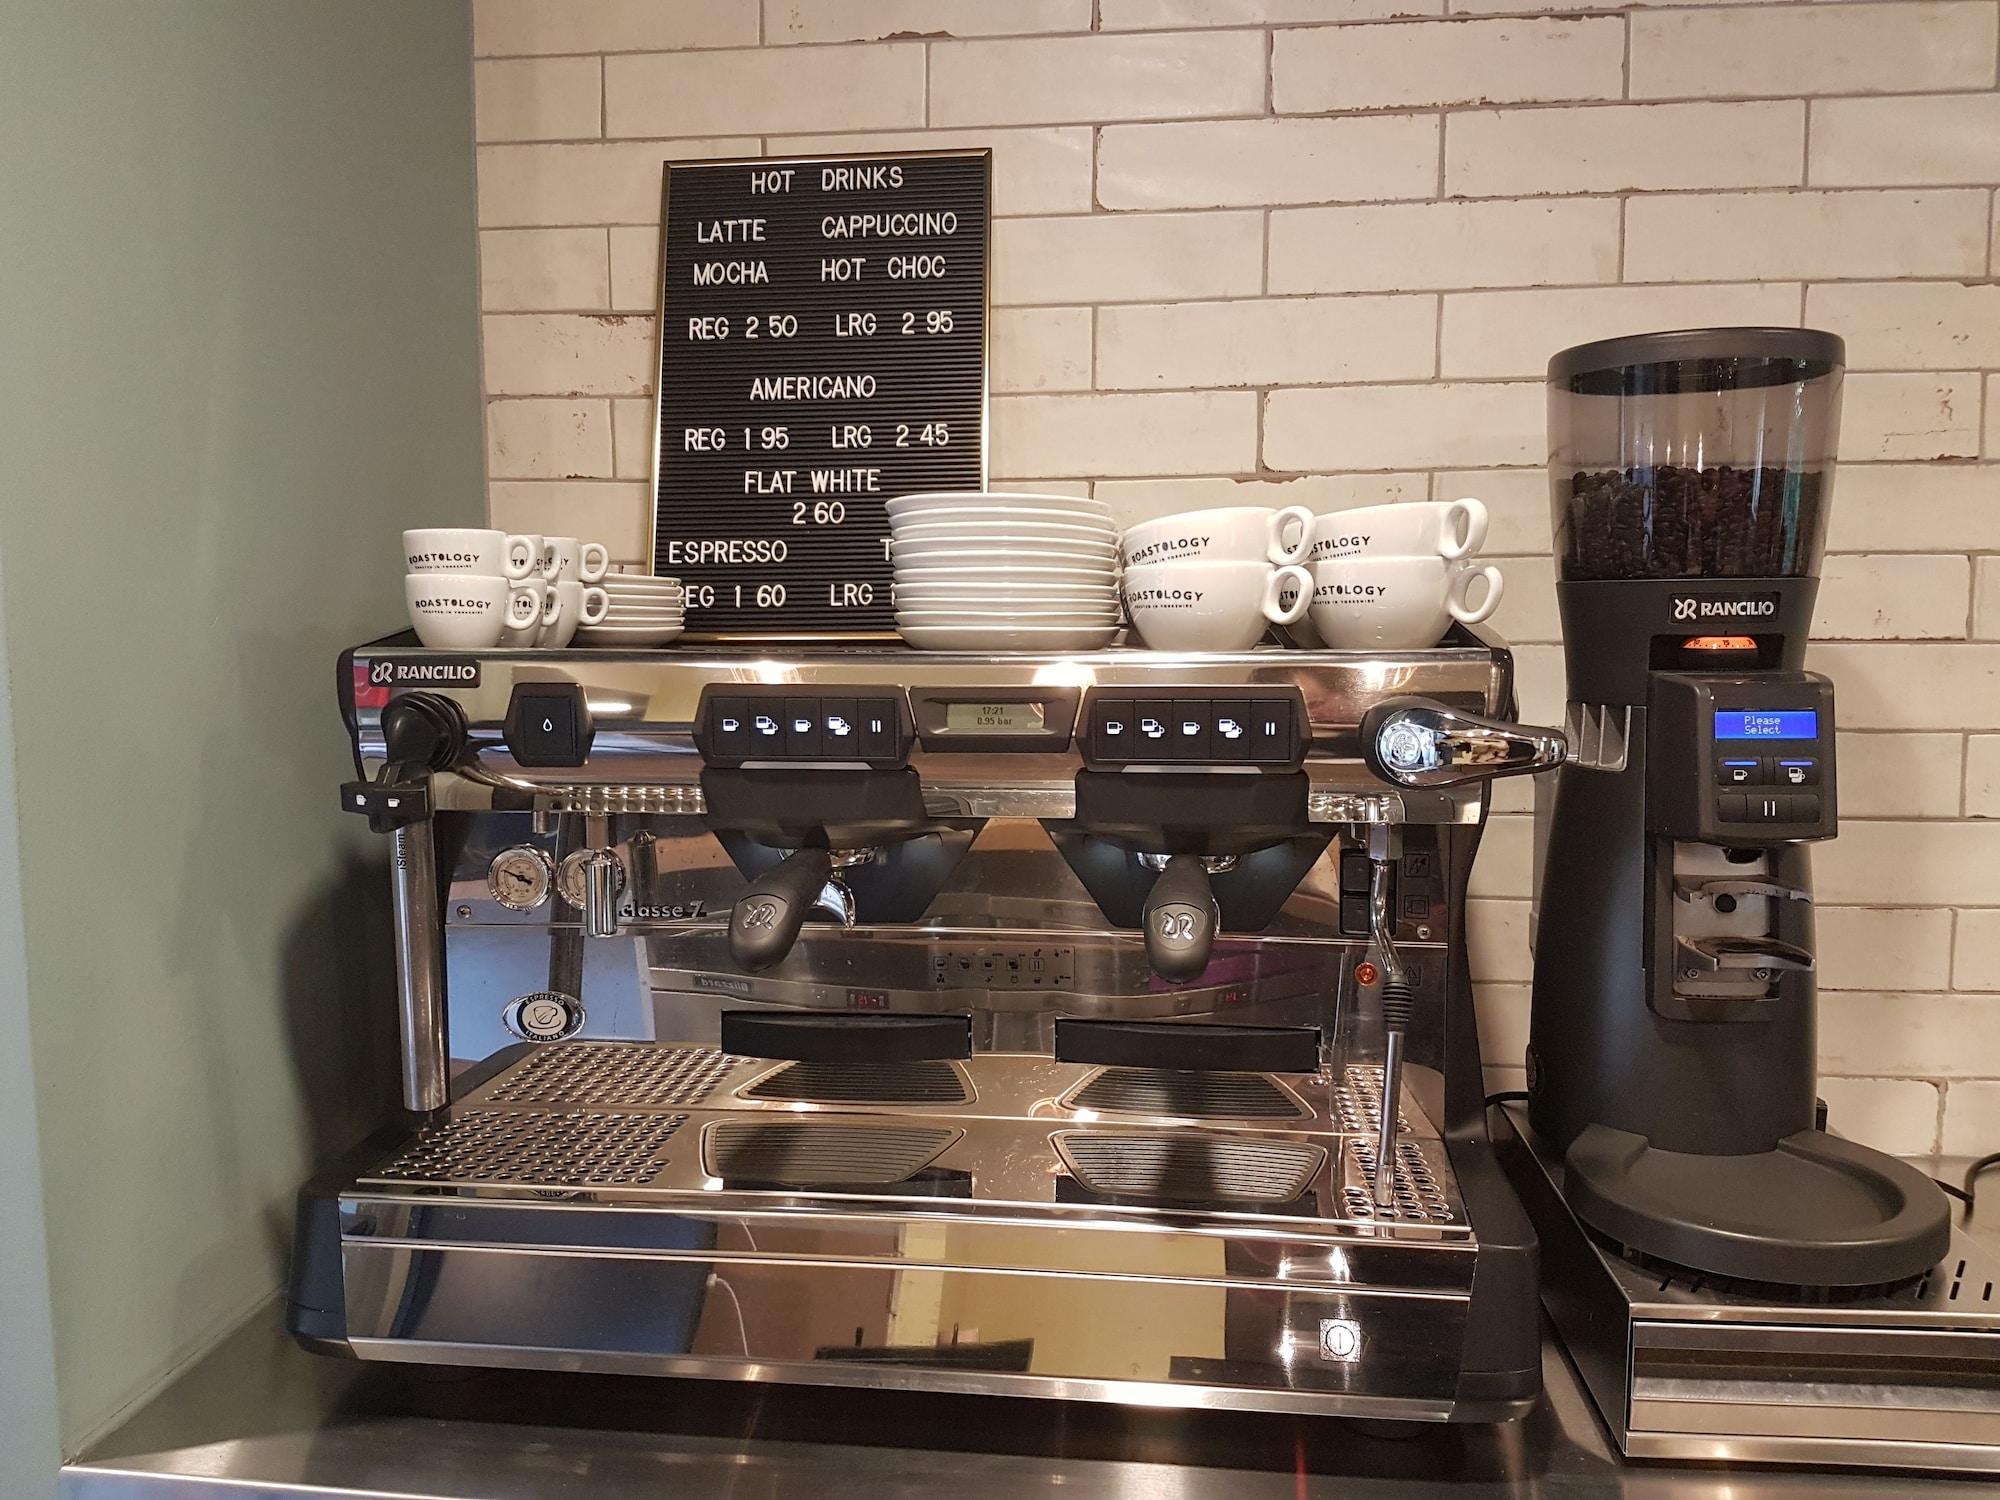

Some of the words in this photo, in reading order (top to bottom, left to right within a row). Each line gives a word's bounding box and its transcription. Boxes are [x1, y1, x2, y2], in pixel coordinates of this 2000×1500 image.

[751, 170, 796, 195] HOT
[821, 166, 904, 191] DRINKS
[697, 218, 767, 243] LATTE
[821, 211, 958, 238] CAPPUCCINO
[693, 260, 769, 286] MOCHA
[821, 257, 867, 282] HOT
[887, 255, 946, 279] CHOC
[688, 316, 729, 341] REG
[835, 312, 877, 336] LRG
[749, 374, 876, 401] AMERICANO
[684, 427, 726, 452] REG
[831, 424, 872, 448] LRG
[744, 470, 797, 494] FLAT
[810, 468, 881, 493] WHITE
[668, 539, 788, 564] ESPRESSO
[1311, 536, 1371, 554] STOLOGY
[830, 583, 873, 607] LRG
[1312, 585, 1386, 597] ASTOLOGY
[415, 599, 491, 610] ROASTOLOGY
[1700, 601, 1775, 617] RANCILIO
[396, 665, 477, 680] RANCILIO
[982, 706, 1004, 715] 17:21
[977, 716, 995, 726] 0.95
[998, 716, 1012, 726] bar
[1744, 715, 1781, 725] Please
[1744, 725, 1782, 735] Select
[396, 833, 407, 870] iSteam
[620, 900, 684, 918] classe
[689, 900, 705, 918] 7
[524, 992, 565, 1006] ESPRESSO
[524, 1029, 565, 1041] ITALIANO
